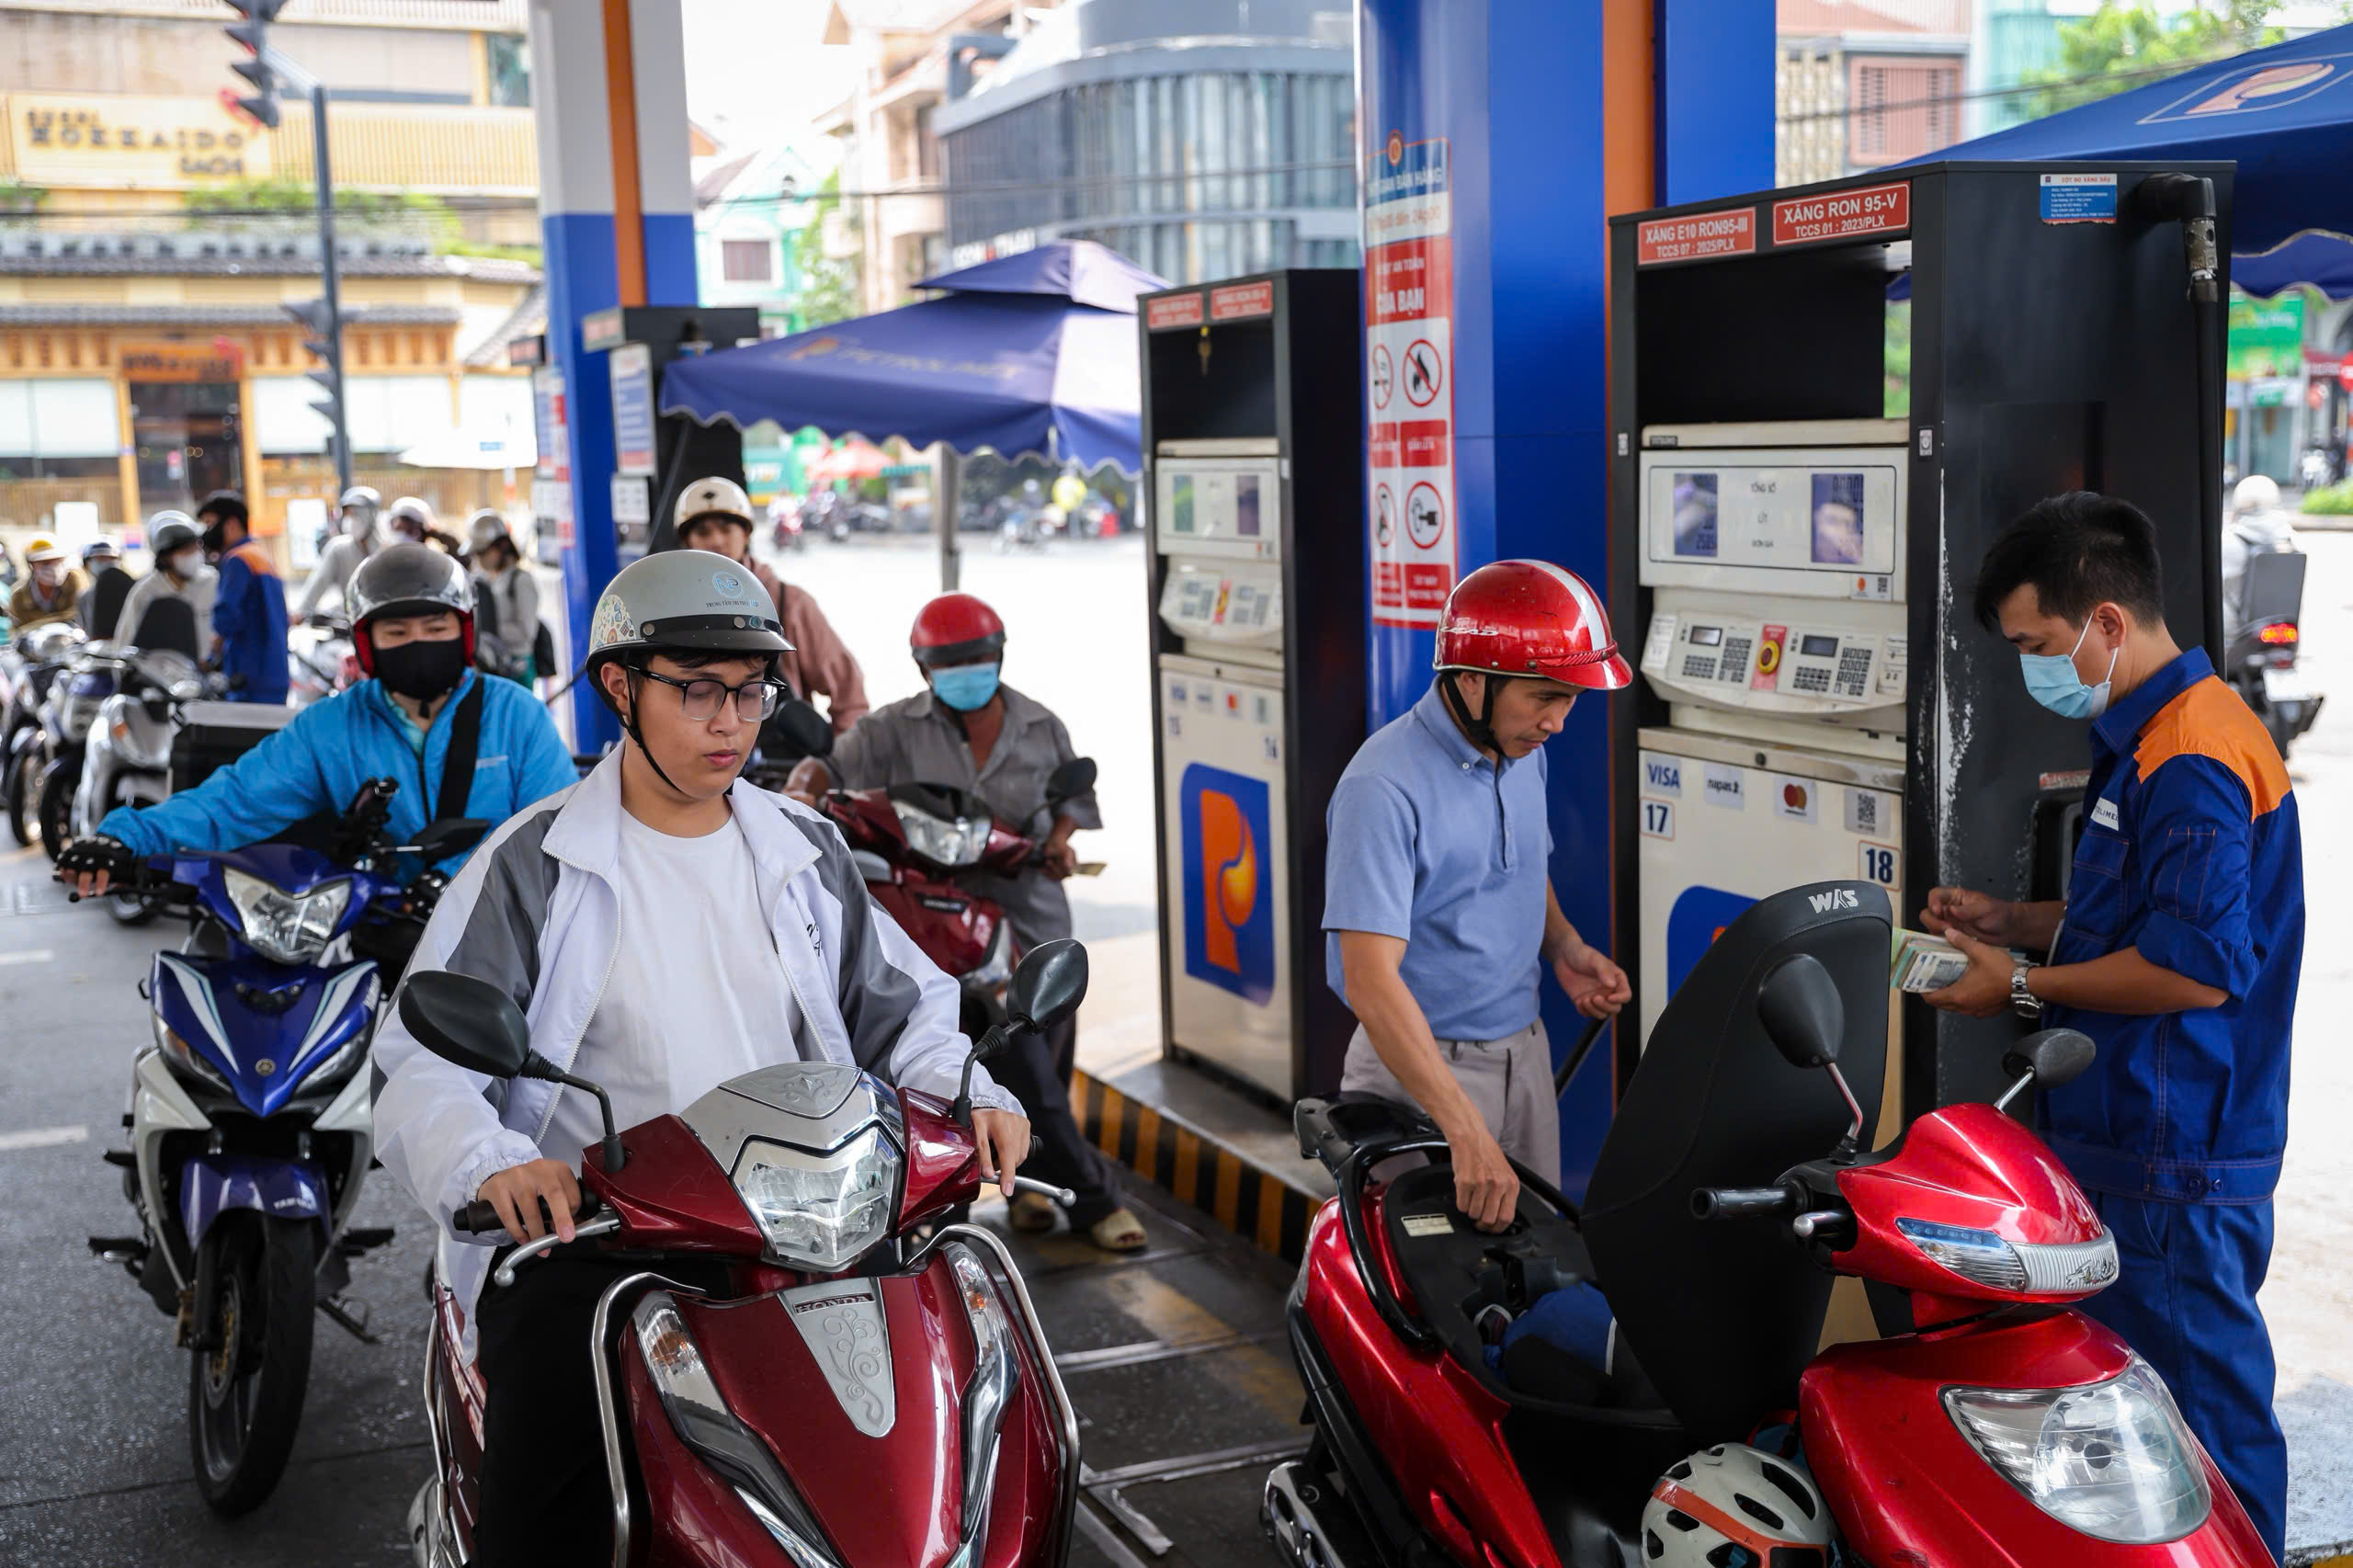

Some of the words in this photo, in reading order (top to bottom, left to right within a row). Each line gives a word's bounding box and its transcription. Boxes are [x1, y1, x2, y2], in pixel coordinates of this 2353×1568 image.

[1784, 203, 1824, 224] XĂNG
[1828, 198, 1860, 218] RON
[1864, 192, 1897, 213] 95-V
[1645, 225, 1676, 244] XĂNG
[1677, 223, 1697, 240] E10
[1698, 216, 1748, 237] RON95-III
[1795, 223, 1820, 238] TCCS
[1823, 222, 1833, 234] 01
[1841, 214, 1885, 232] 2023/PLX
[1656, 244, 1679, 257] TCCS
[1680, 242, 1690, 255] 07
[1697, 237, 1735, 254] 2025/PLX
[1397, 287, 1425, 316] BẠN
[1647, 763, 1680, 789] VISA
[1646, 803, 1668, 833] 17
[1866, 847, 1893, 884] 18
[795, 1295, 870, 1313] HONDA
